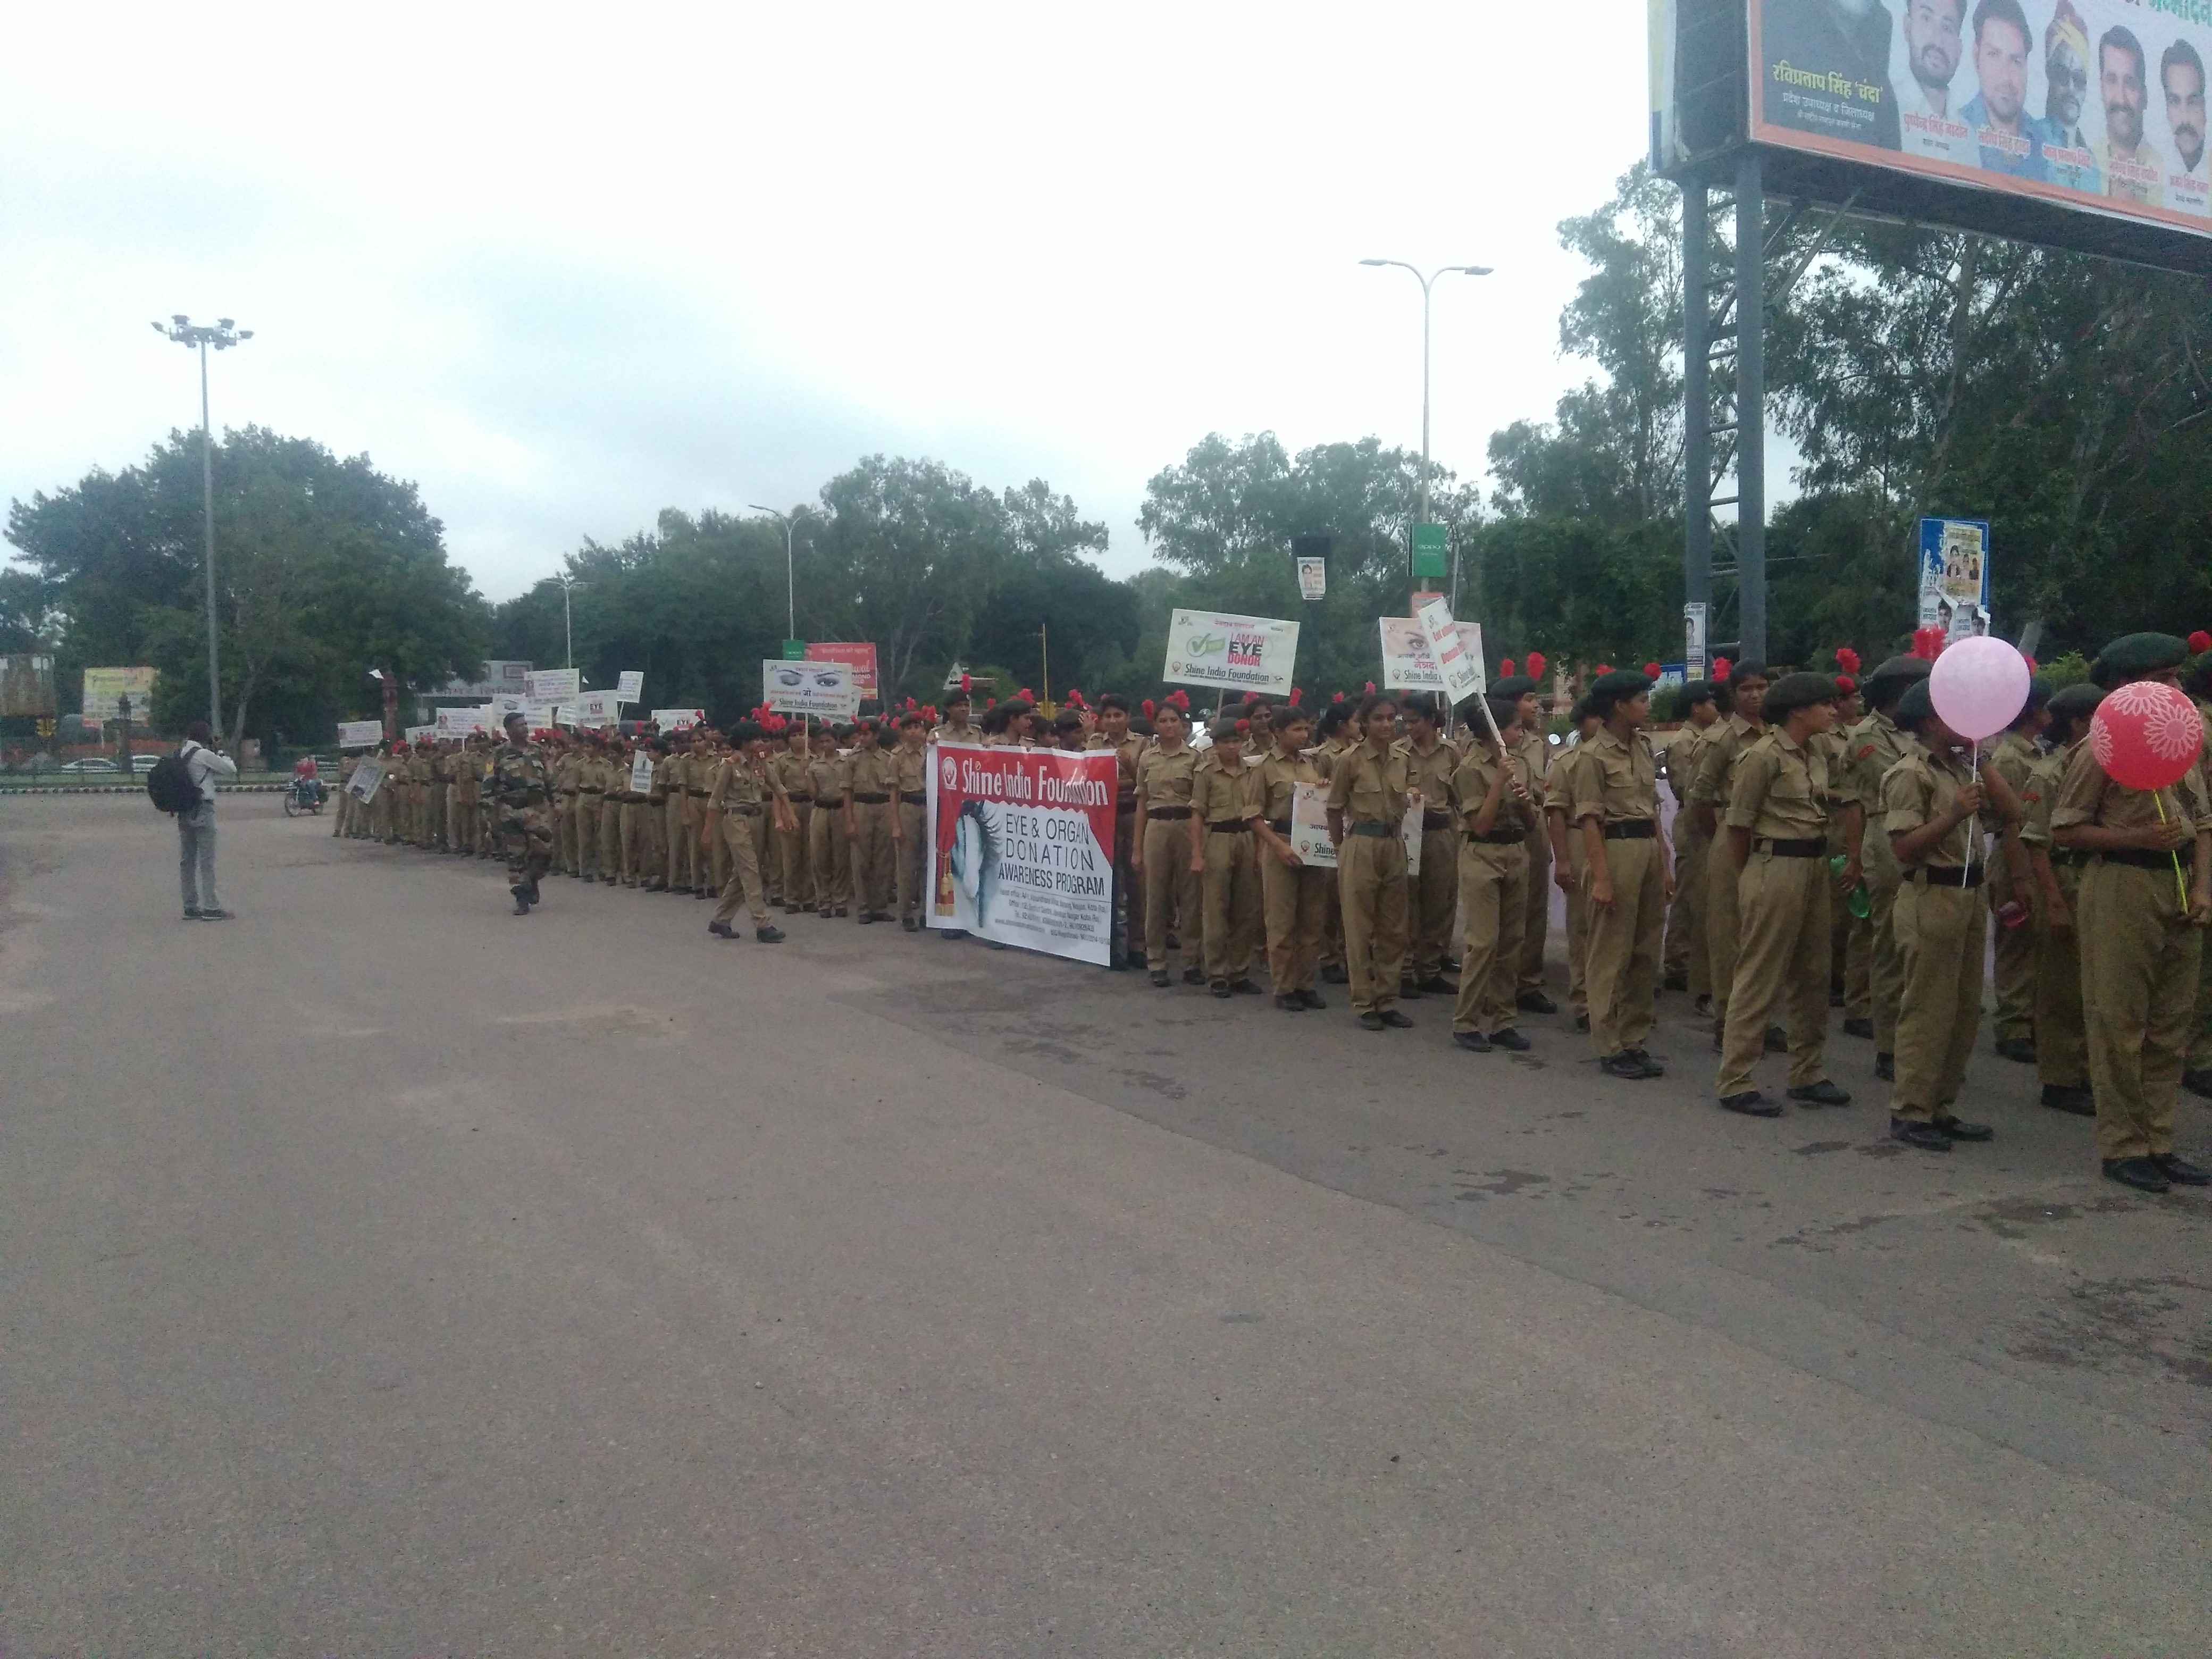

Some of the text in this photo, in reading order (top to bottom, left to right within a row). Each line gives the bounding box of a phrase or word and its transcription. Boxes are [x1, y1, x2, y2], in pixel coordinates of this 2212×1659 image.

[1773, 60, 1825, 90] रविप्रताप
[1828, 71, 1852, 99] सिंह
[1234, 633, 1250, 643] AM
[1252, 634, 1264, 645] AN
[1228, 641, 1263, 657] EYE
[1227, 652, 1261, 666] DONOR
[1413, 658, 1438, 670] नेत्रदा
[1185, 664, 1205, 676] Shine
[1207, 666, 1225, 677] India
[1228, 668, 1269, 682] Foundation
[1404, 669, 1438, 680] Shine India
[962, 757, 1109, 806] Shine India Foundation
[1006, 813, 1090, 845] EYE & ORGAN
[1006, 838, 1094, 871] DONATION
[999, 862, 1104, 895] AWARENESS PROGRAM
